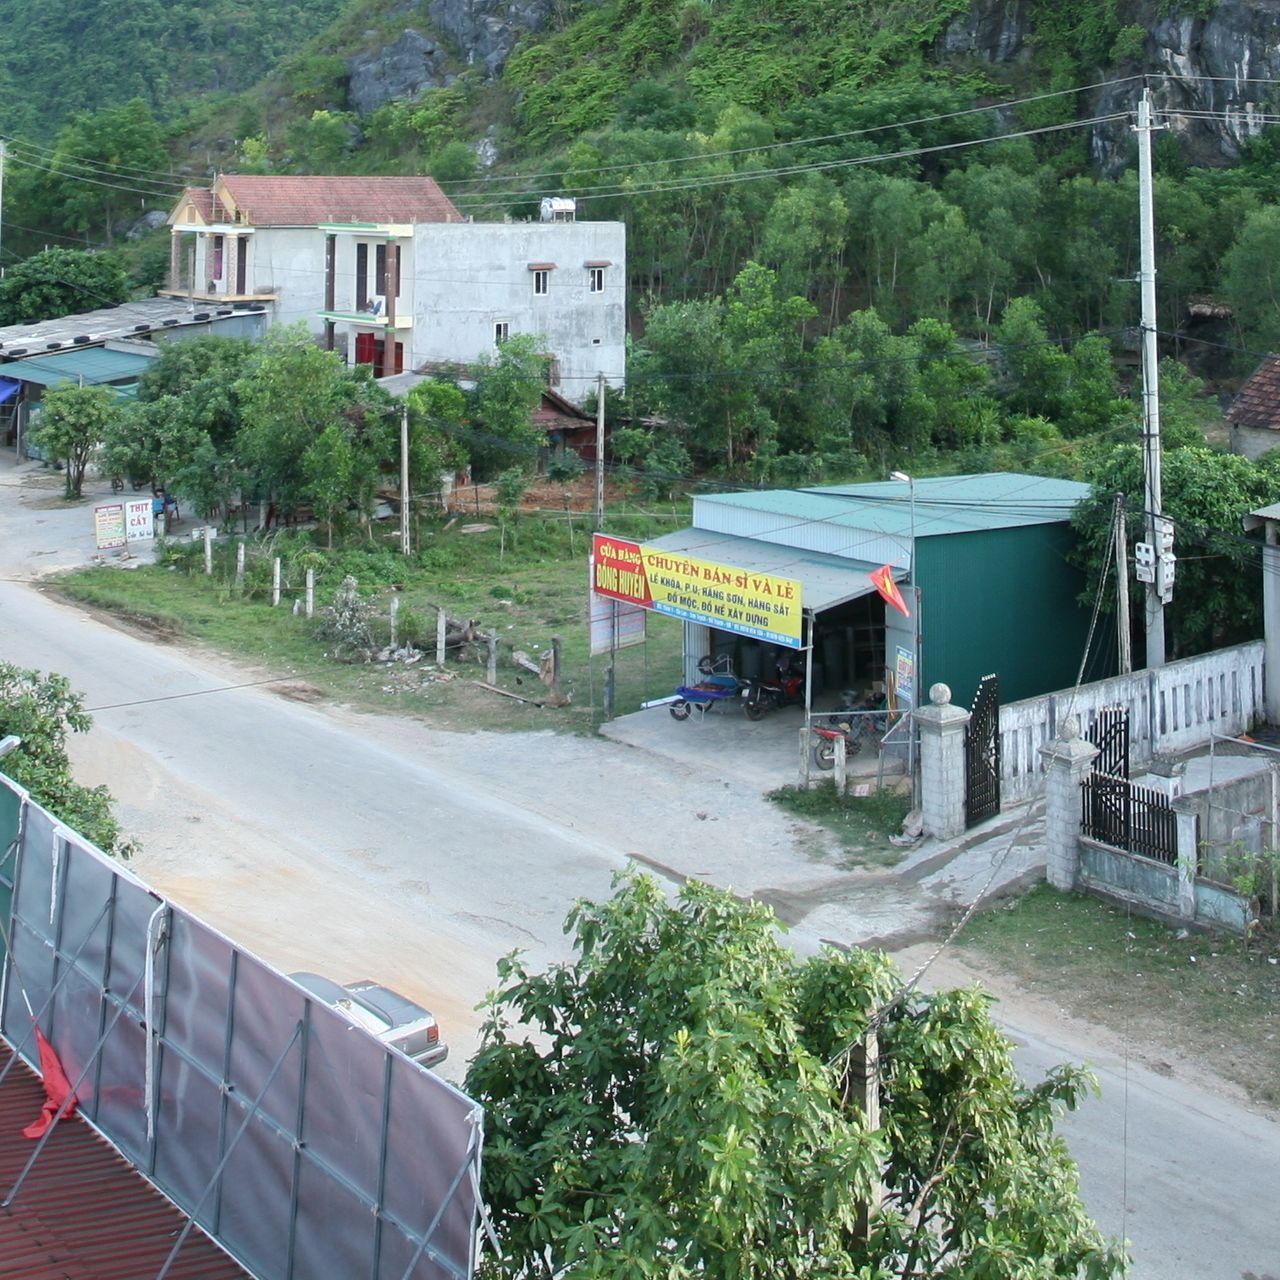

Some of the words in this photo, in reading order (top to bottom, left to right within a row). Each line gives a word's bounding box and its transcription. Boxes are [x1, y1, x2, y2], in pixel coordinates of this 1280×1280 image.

[647, 554, 700, 578] CHUYÊN
[703, 567, 731, 584] BÁN
[753, 578, 772, 595] VÀ
